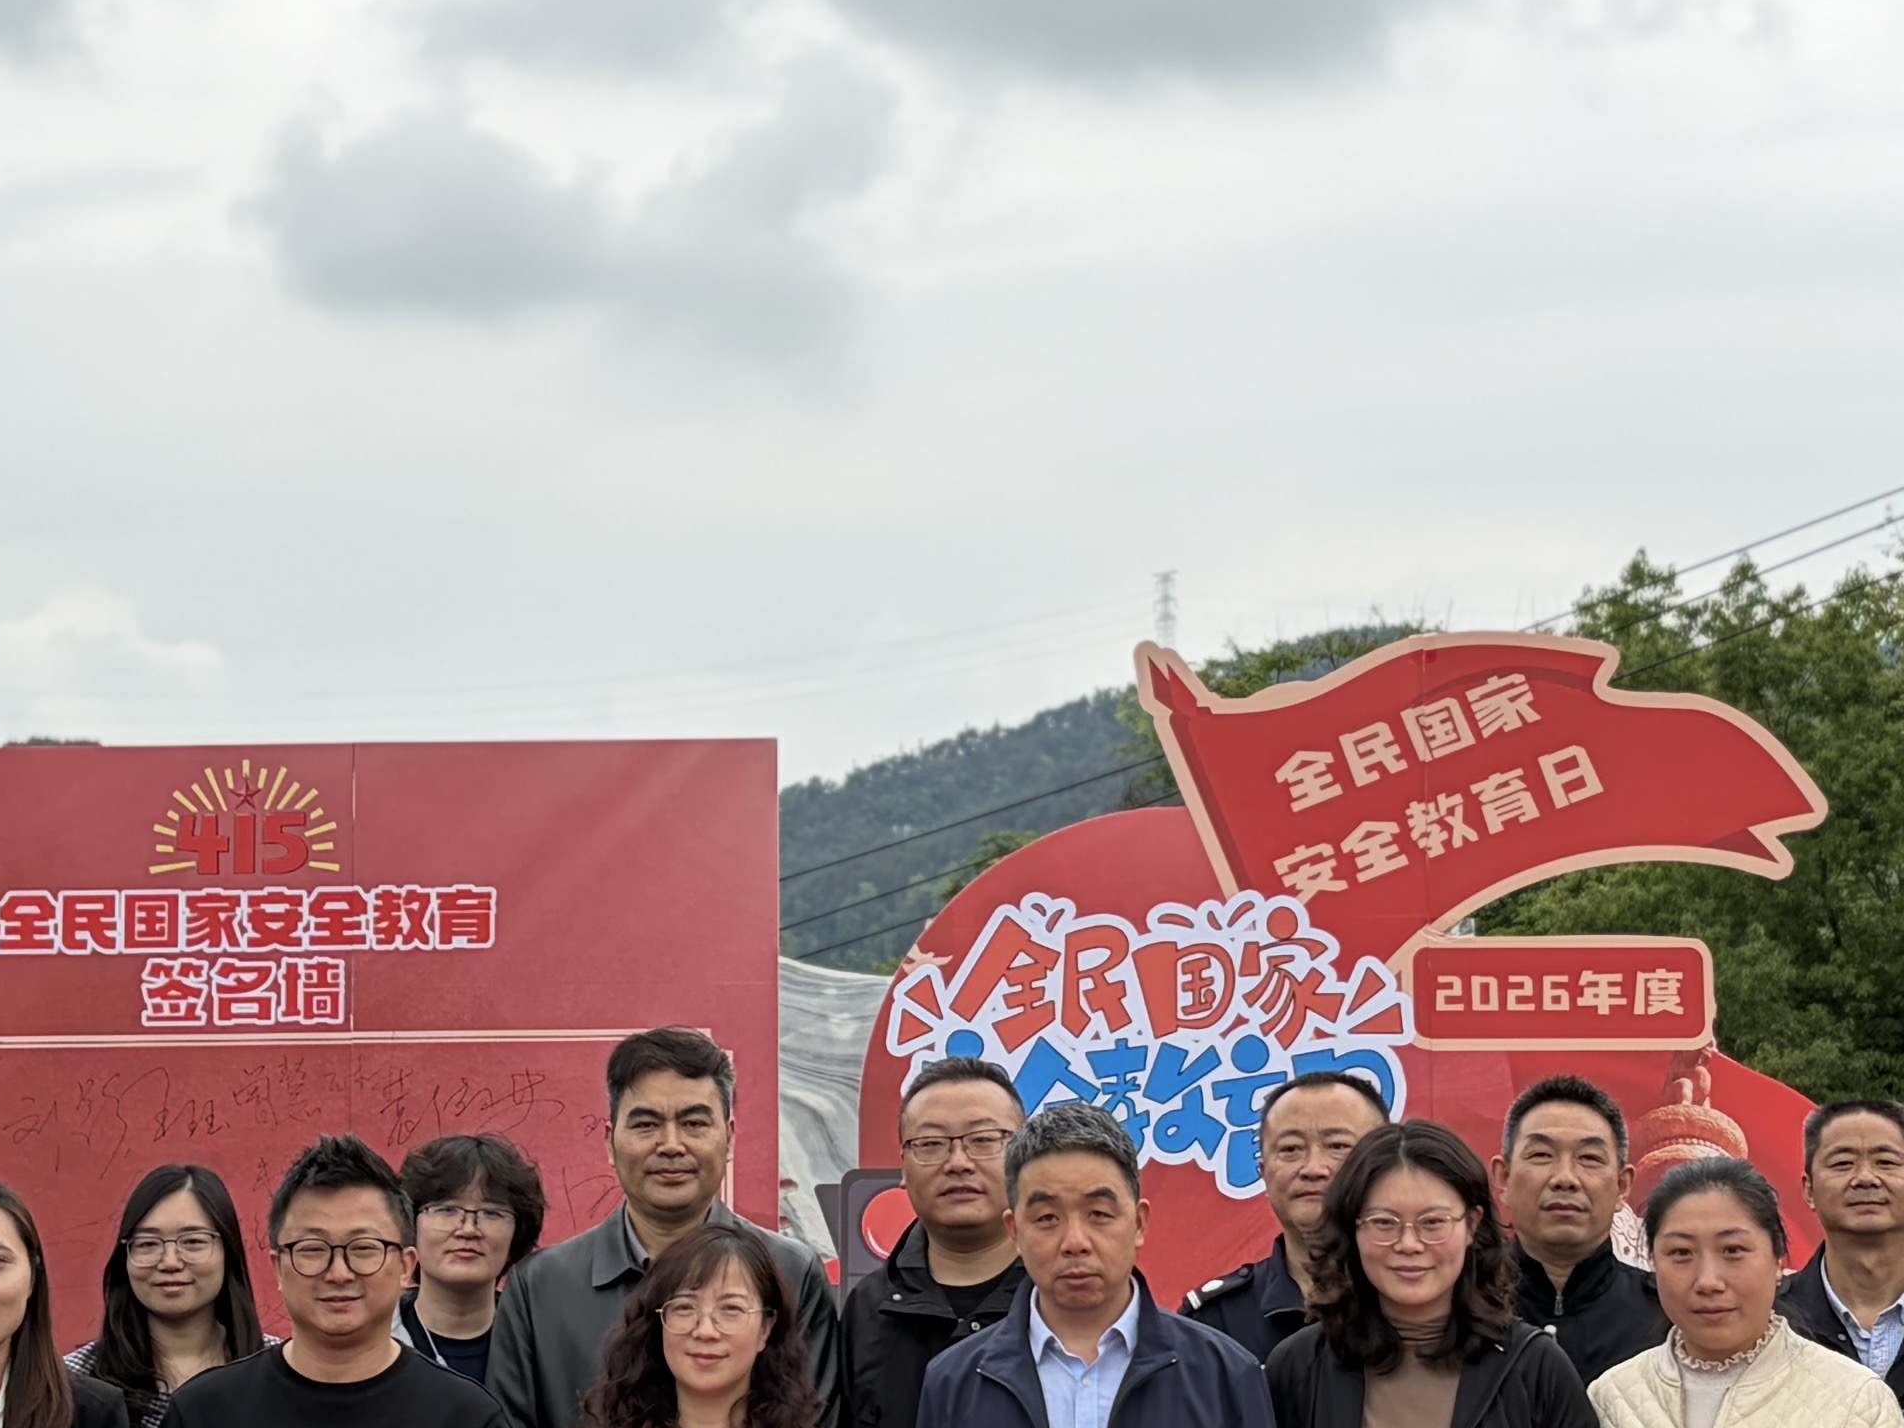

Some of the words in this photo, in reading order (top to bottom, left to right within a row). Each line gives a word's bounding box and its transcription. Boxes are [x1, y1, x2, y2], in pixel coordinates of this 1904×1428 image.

[1275, 671, 1543, 814] 全民国家
[172, 810, 312, 876] 415
[1273, 744, 1606, 902] 安全教育日
[141, 956, 346, 1027] 签名墙
[949, 905, 1348, 1053] 全民国家
[1434, 968, 1686, 1017] 2026年度
